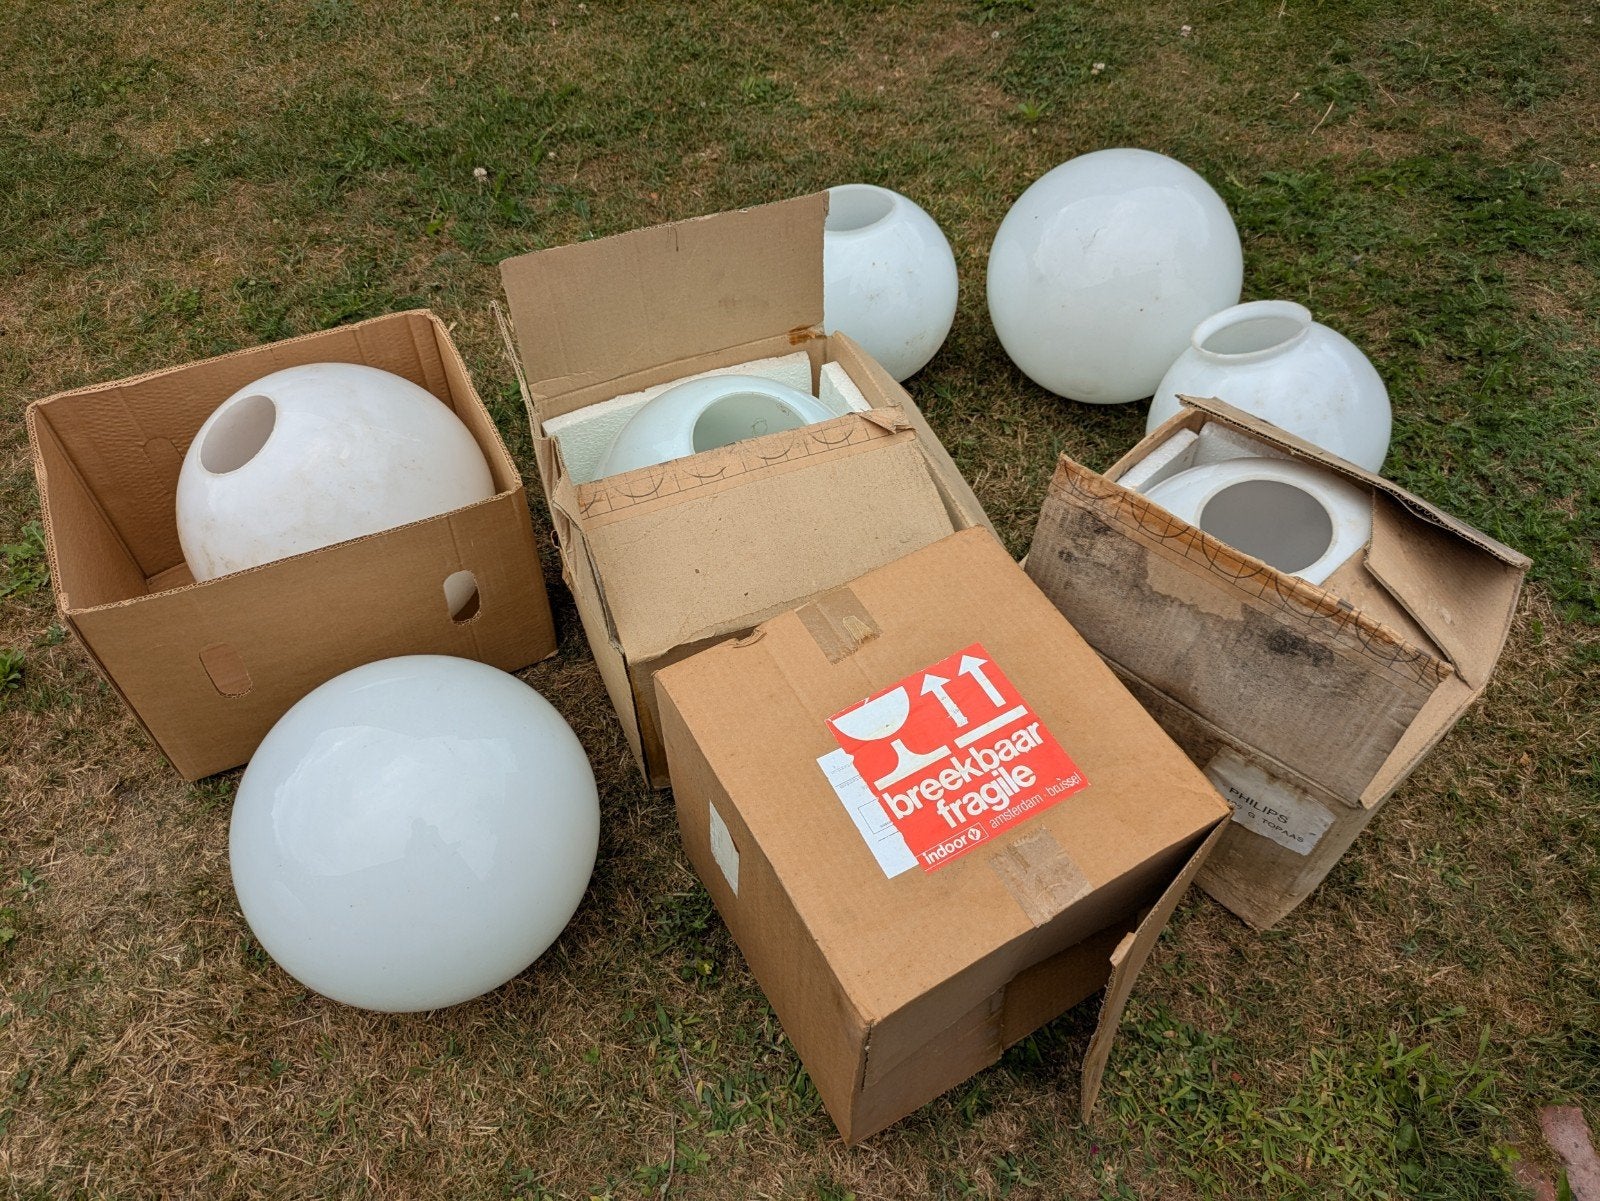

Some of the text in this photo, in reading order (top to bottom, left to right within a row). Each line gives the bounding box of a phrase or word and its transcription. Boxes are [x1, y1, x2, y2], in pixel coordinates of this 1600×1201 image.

[882, 721, 1044, 820] breekbaar
[936, 764, 1037, 829] fragile
[988, 793, 1044, 829] amsterdam
[1229, 787, 1289, 824] PHILIPS
[1262, 817, 1304, 843] TOPAAS
[923, 834, 968, 865] indoor
